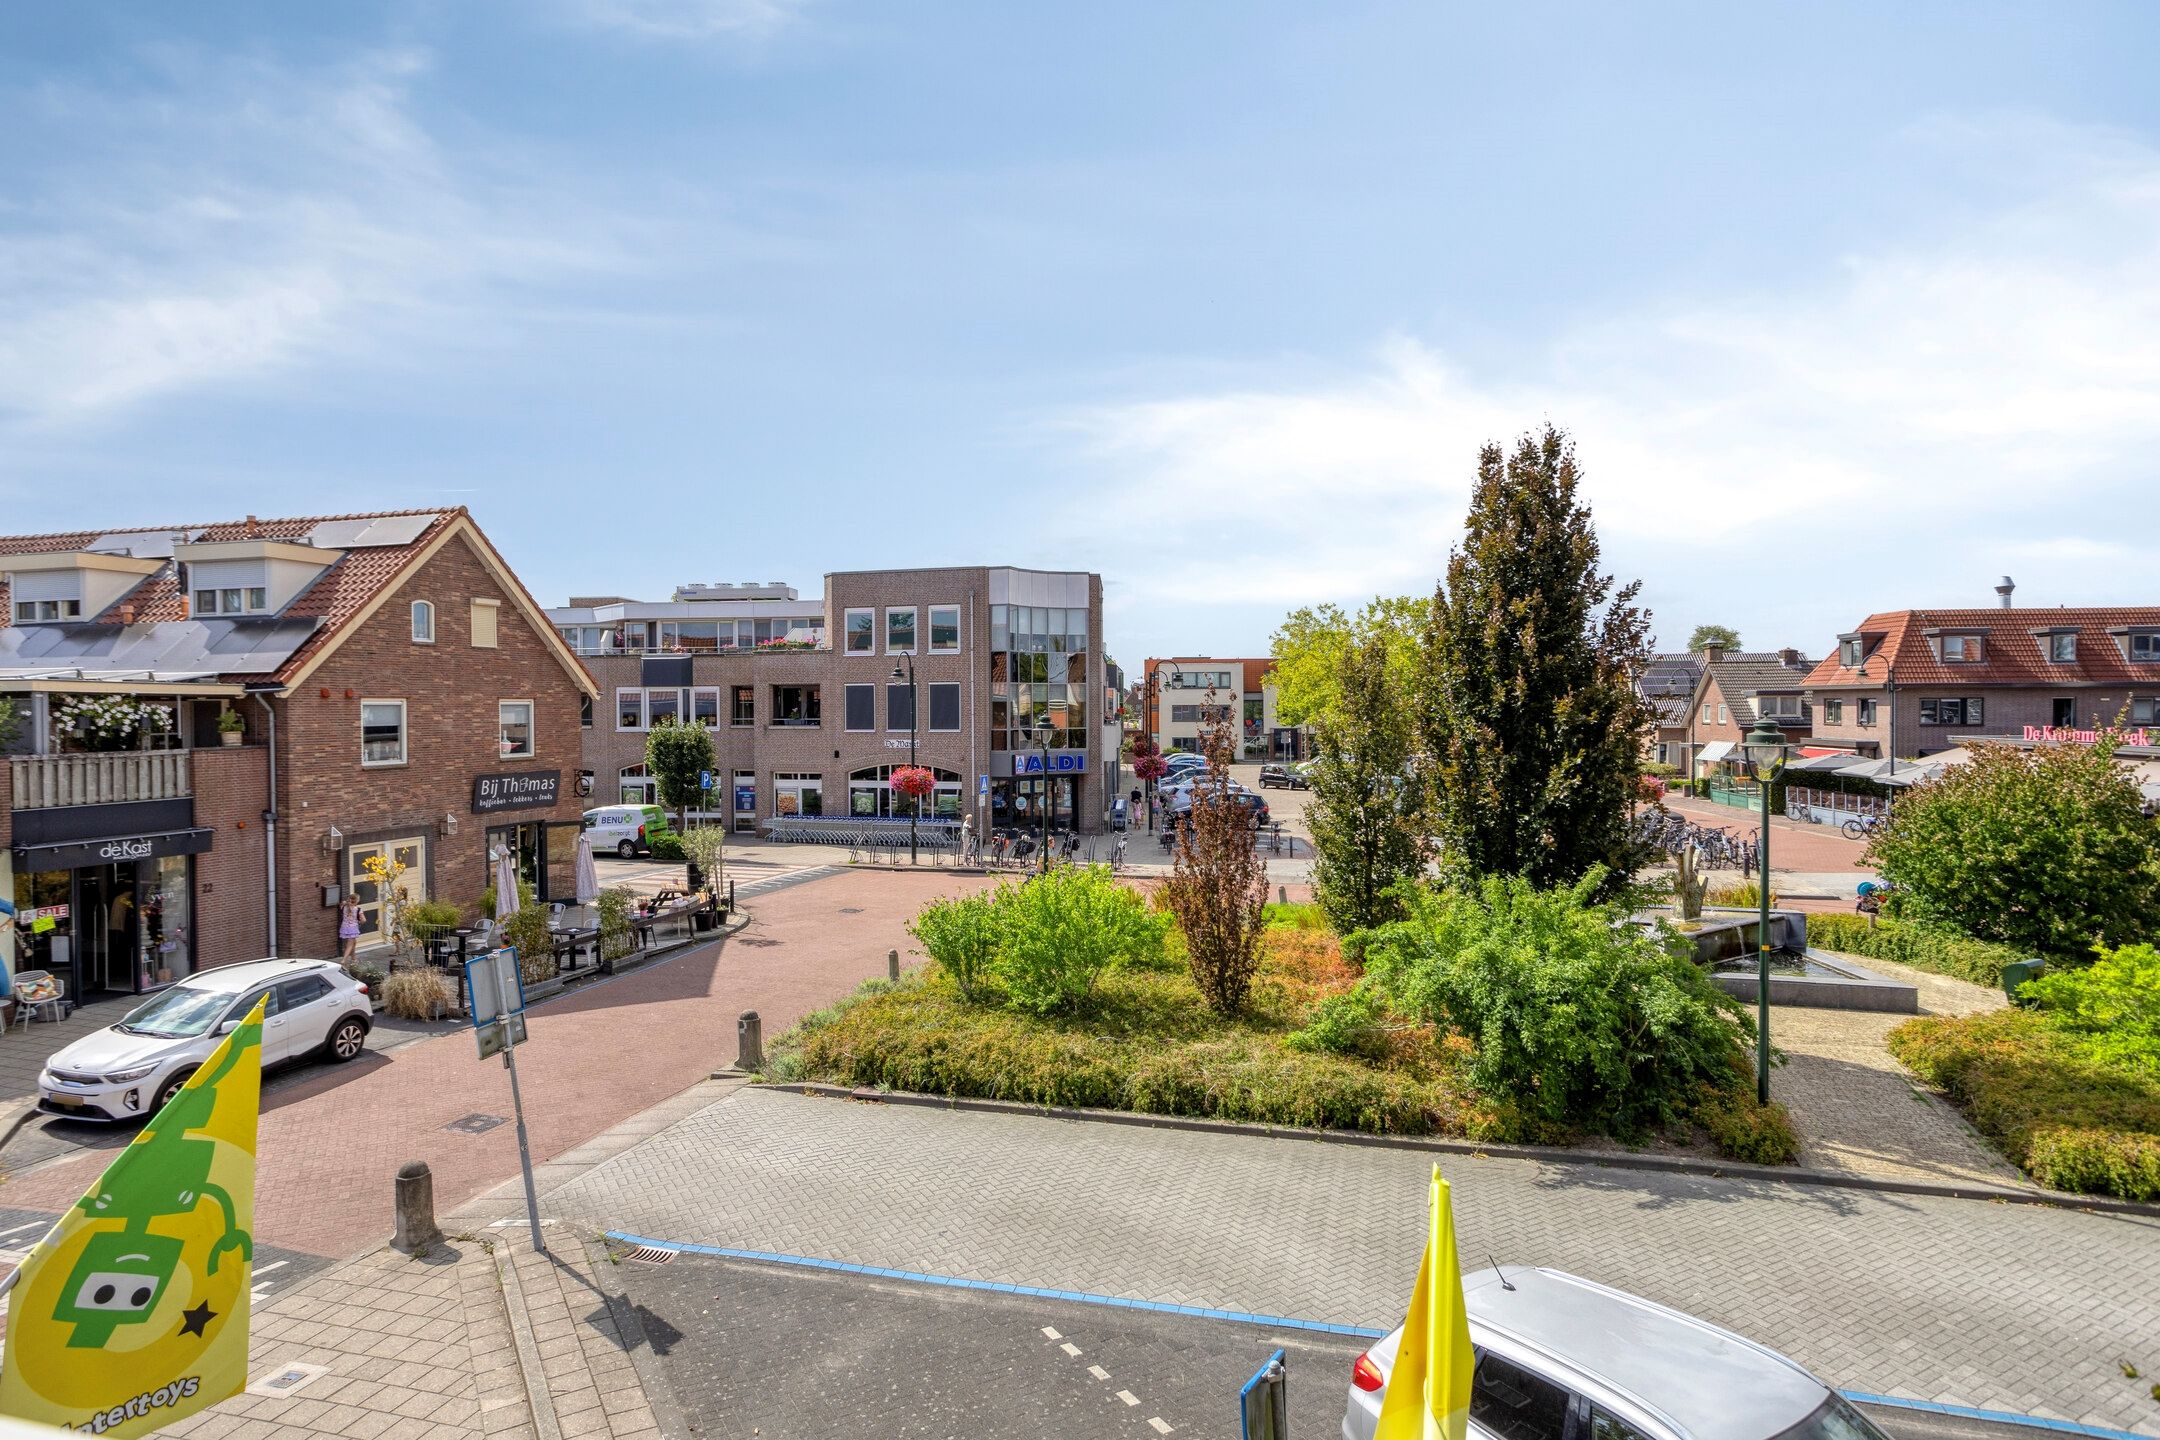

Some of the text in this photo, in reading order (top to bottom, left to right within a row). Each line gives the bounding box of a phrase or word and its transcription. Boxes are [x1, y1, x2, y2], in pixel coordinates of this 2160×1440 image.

[2023, 725, 2040, 741] De
[1027, 755, 1085, 773] ALDI
[703, 773, 709, 787] P
[481, 779, 498, 798] Bij
[601, 816, 624, 824] BENU
[203, 883, 213, 893] 22
[38, 906, 67, 918] SALE
